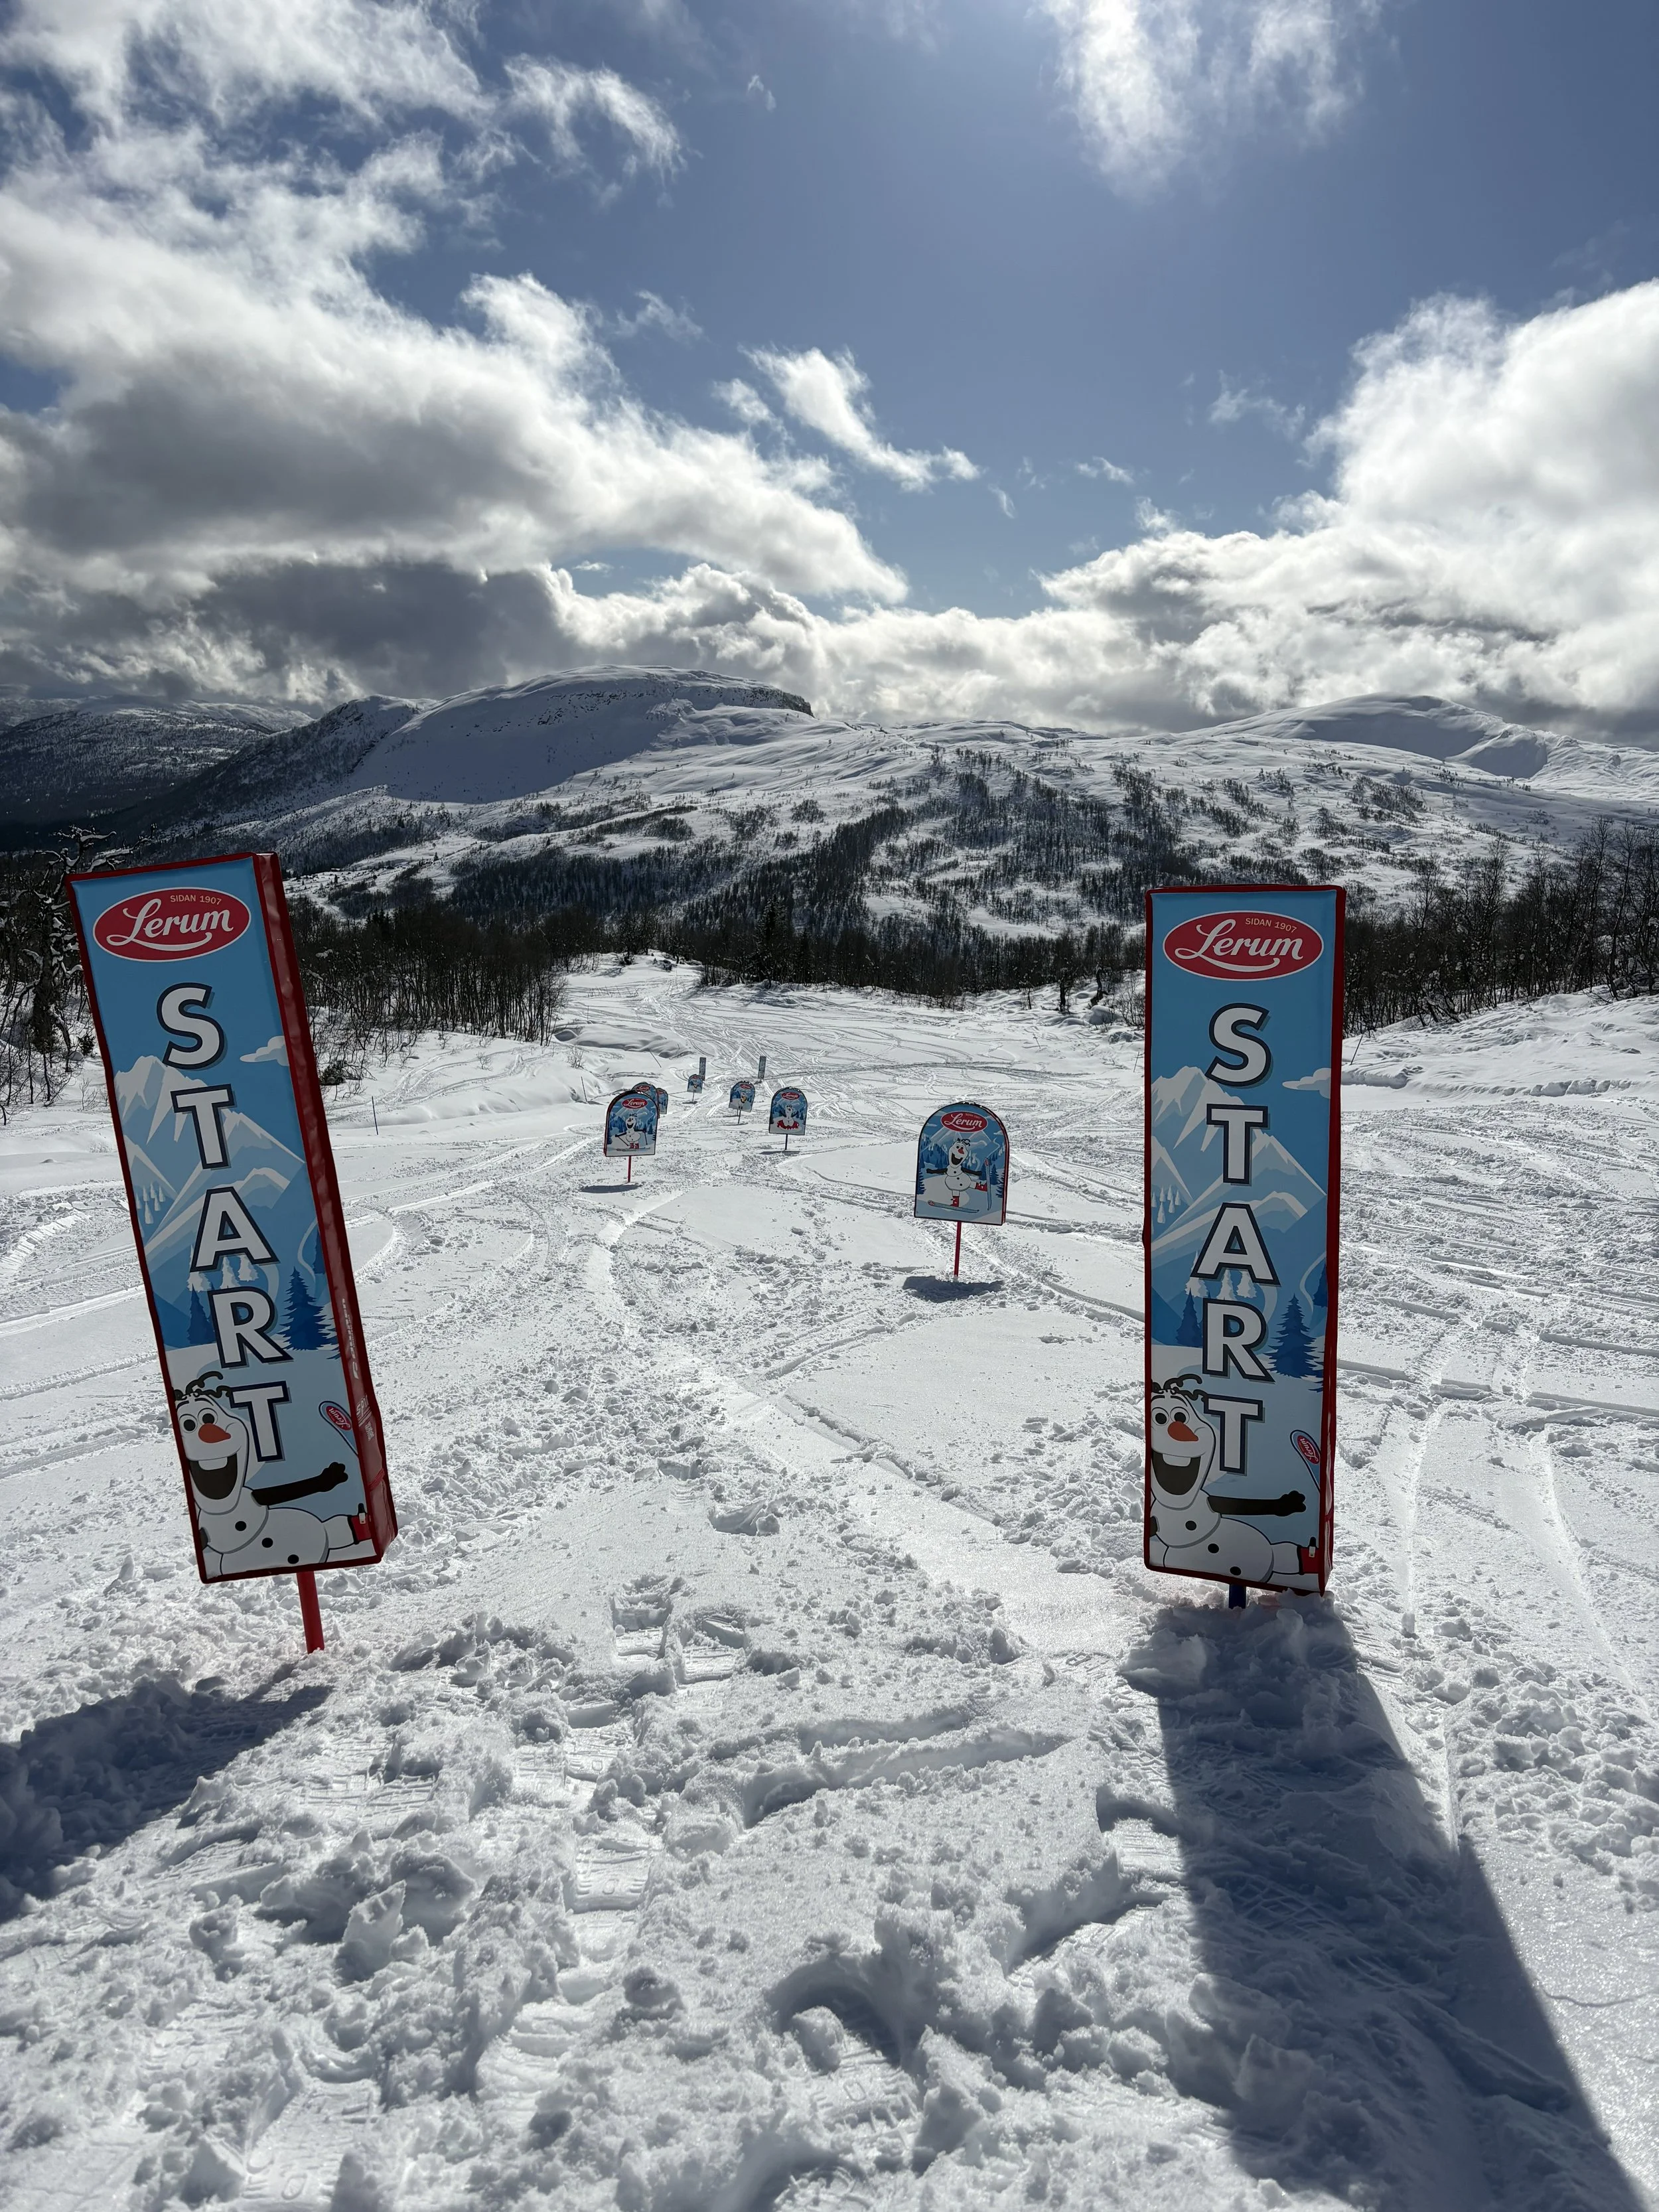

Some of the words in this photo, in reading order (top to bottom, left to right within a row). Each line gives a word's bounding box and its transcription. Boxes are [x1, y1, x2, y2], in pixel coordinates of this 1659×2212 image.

[170, 895, 196, 903] SIDAN
[200, 895, 222, 906] 1907
[106, 899, 234, 952] Lerum
[1245, 918, 1271, 927] SIDAN
[1275, 921, 1297, 934] 1907
[1175, 919, 1303, 972] Lerum
[624, 1099, 646, 1108] Lerum
[944, 1113, 982, 1130] Lerum
[156, 982, 293, 1463] START
[1190, 1003, 1282, 1476] START
[329, 1408, 350, 1428] Lerum
[1300, 1438, 1319, 1462] Lerum
